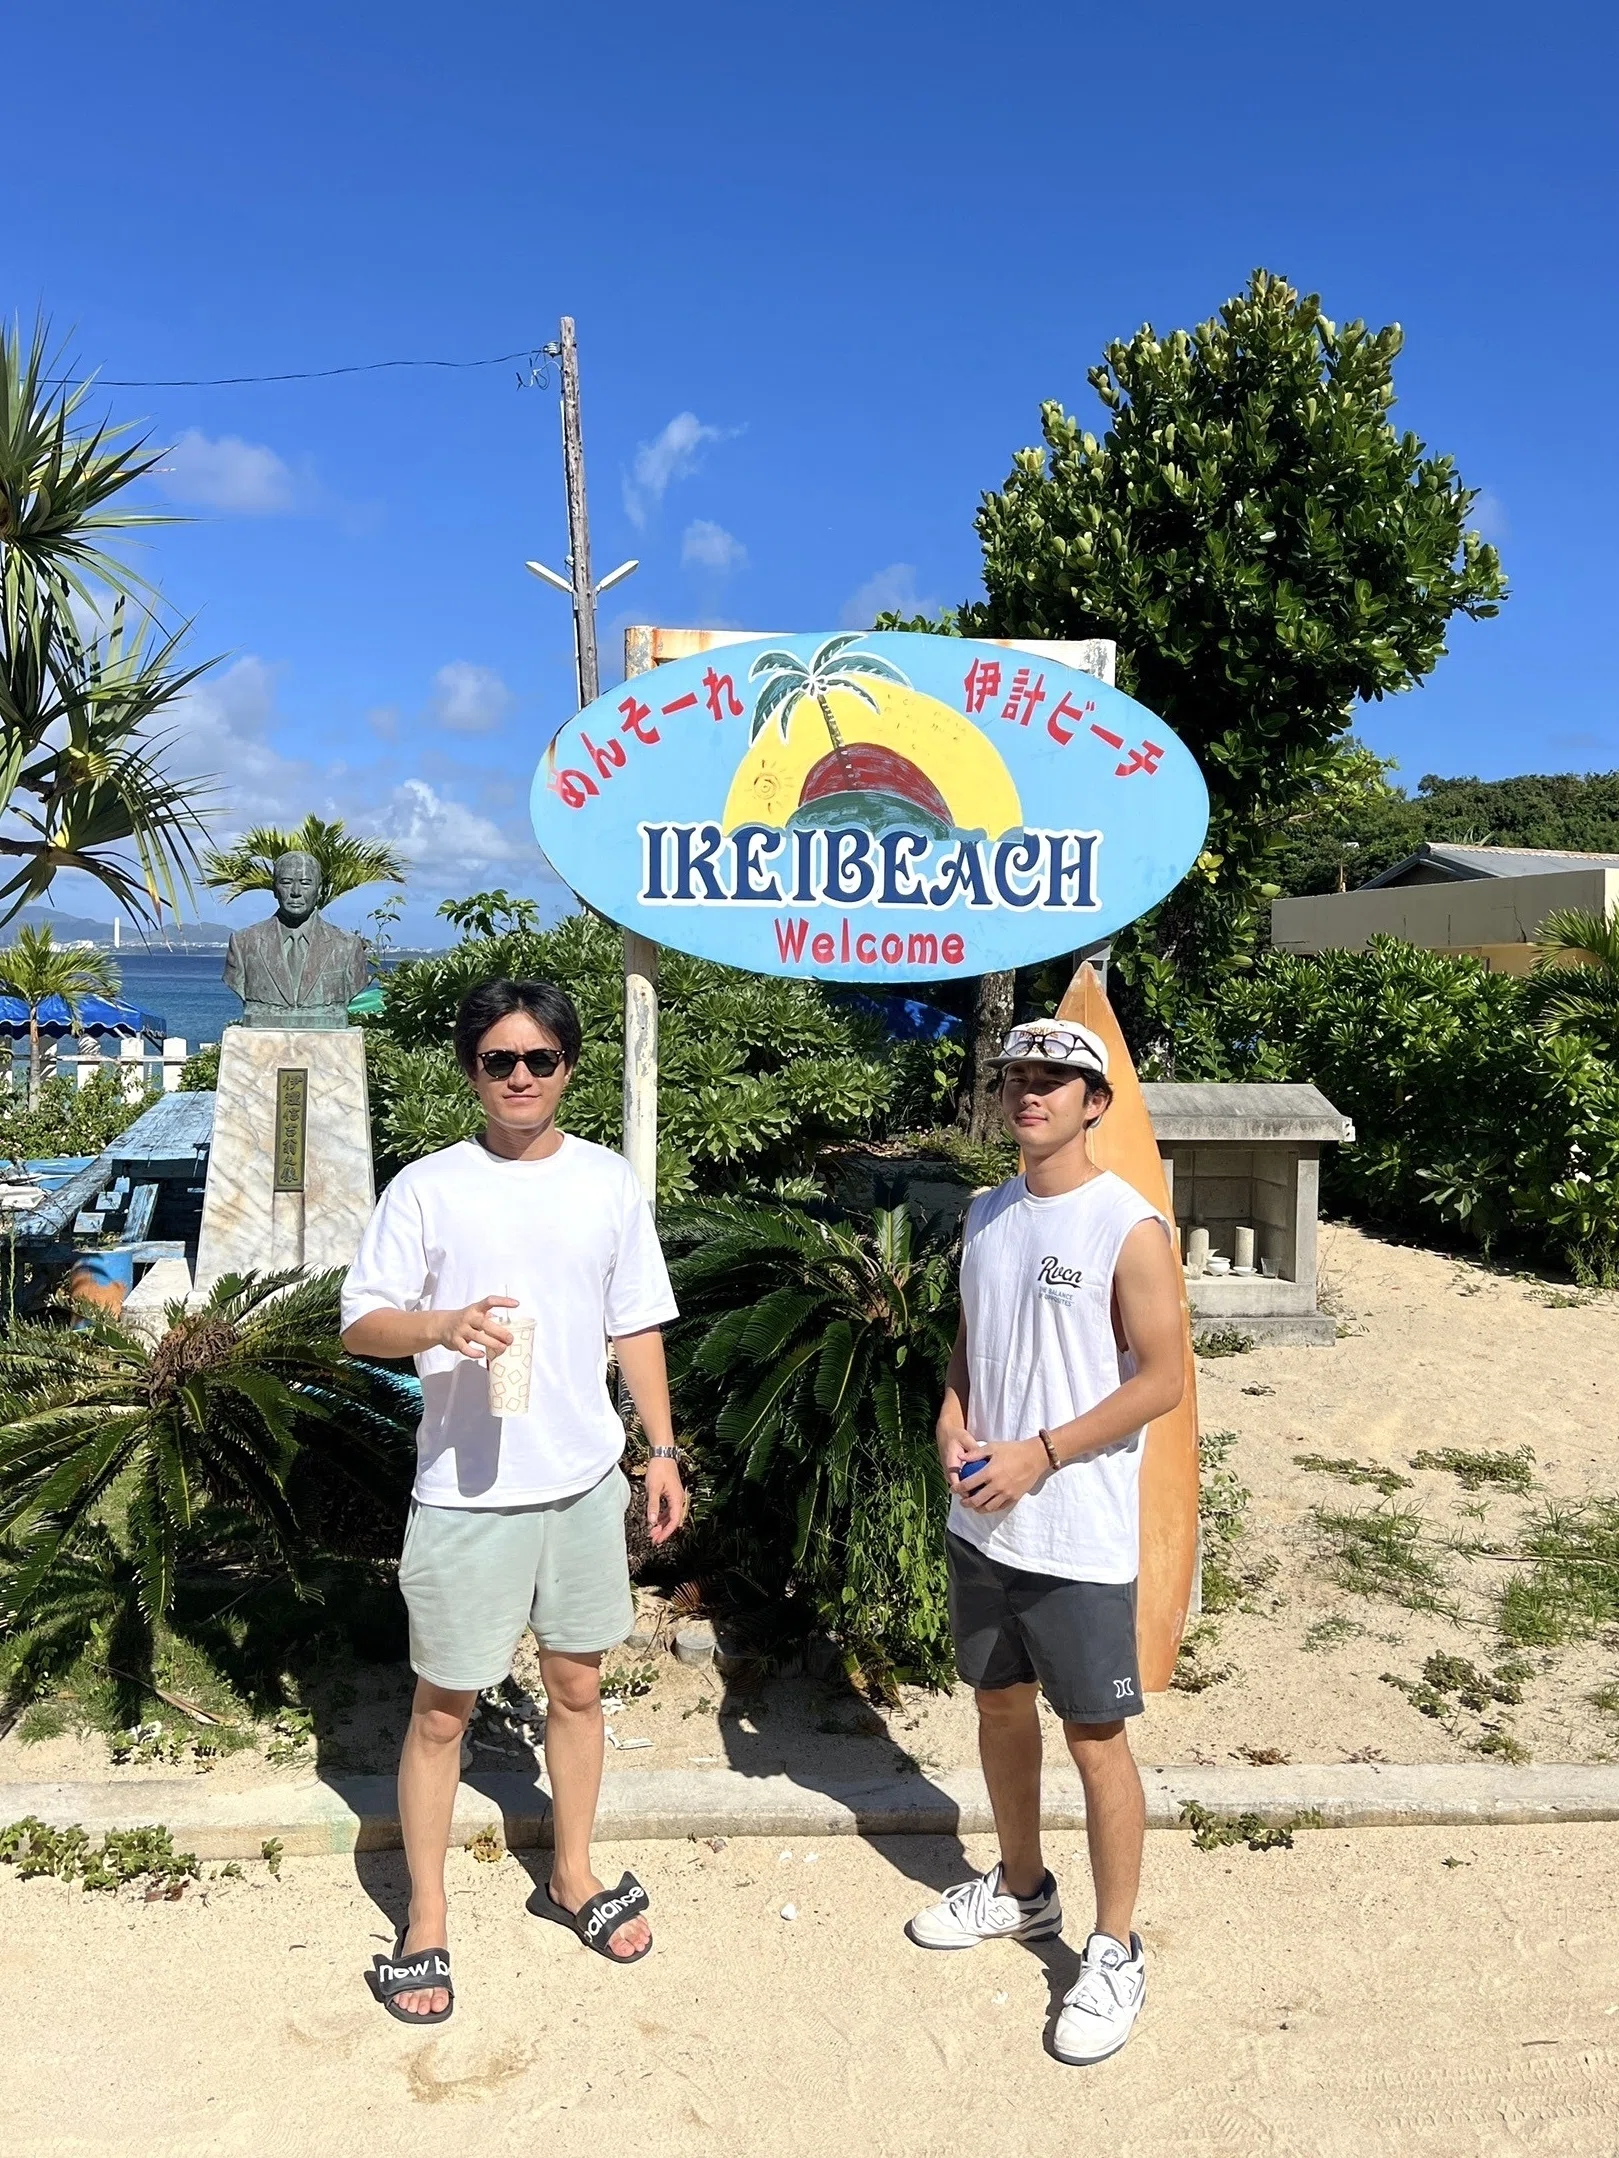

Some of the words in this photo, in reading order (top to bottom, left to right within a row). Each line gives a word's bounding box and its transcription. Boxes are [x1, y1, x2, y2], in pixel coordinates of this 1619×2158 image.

[547, 667, 744, 808] めんそーれ
[964, 657, 1165, 776] 伊計ビーチ
[774, 917, 965, 964] Welcome
